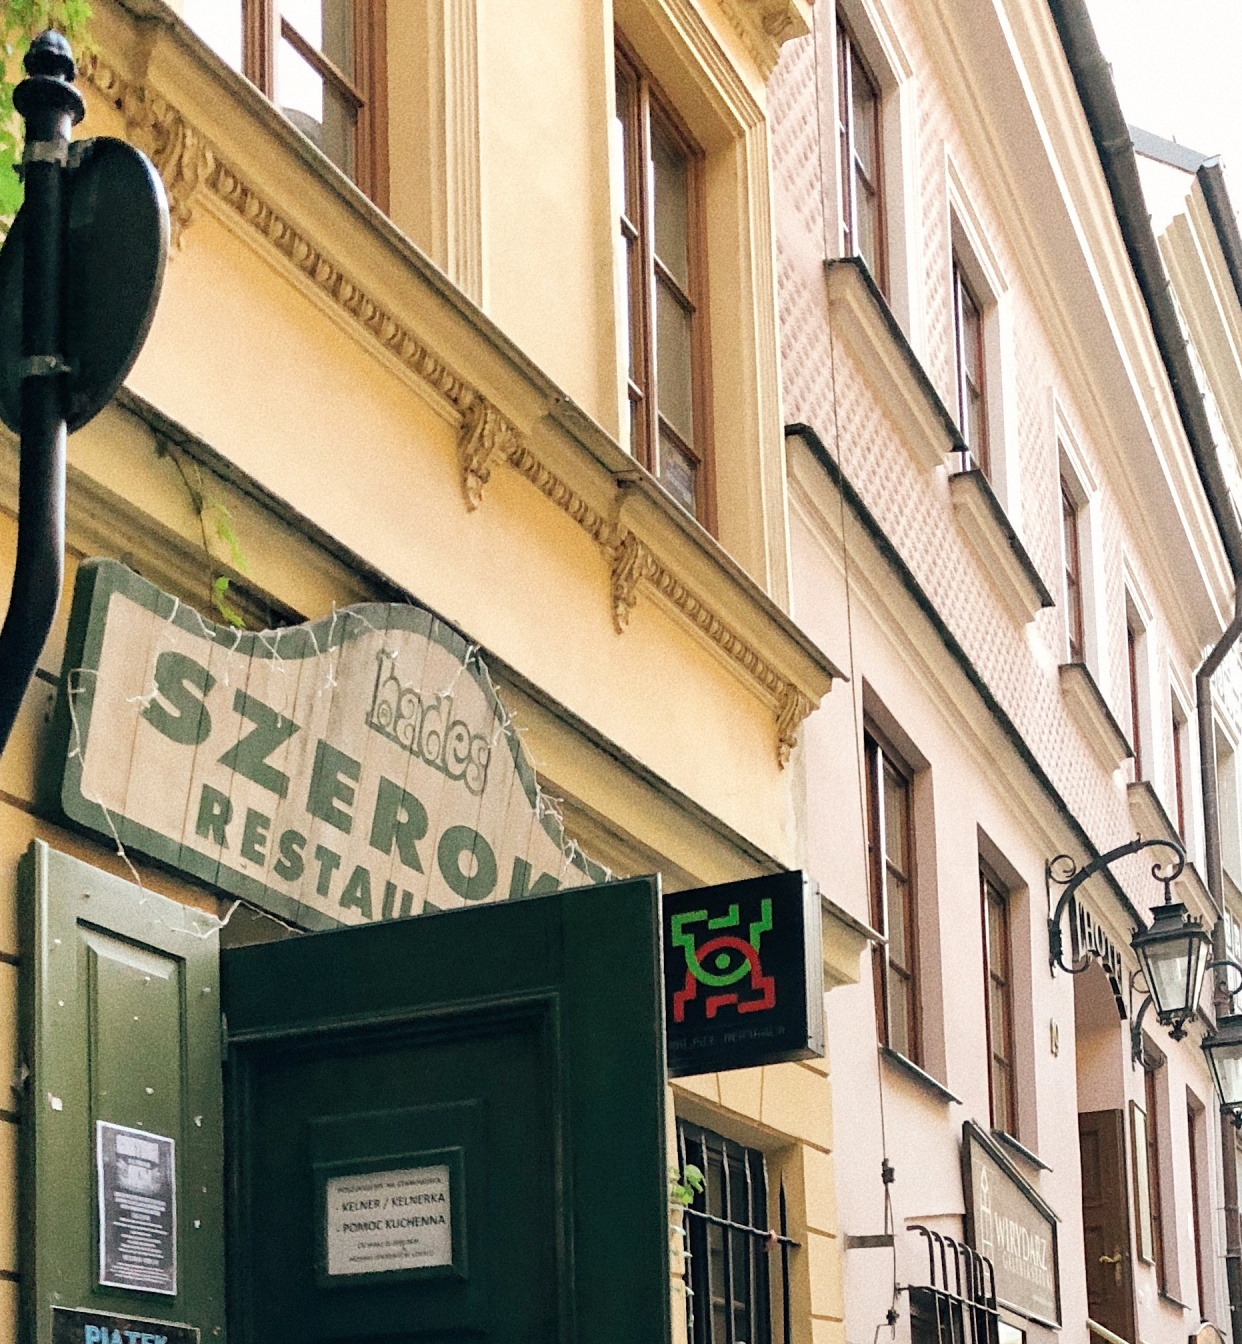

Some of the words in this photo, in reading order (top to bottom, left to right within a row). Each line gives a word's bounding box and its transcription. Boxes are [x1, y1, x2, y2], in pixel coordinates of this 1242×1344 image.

[195, 783, 442, 922] RESTAU
[342, 1199, 380, 1213] KELNER
[391, 1193, 446, 1207] KELNERKA
[342, 1220, 382, 1234] POMOC
[385, 1215, 446, 1230] KUCHENNA
[994, 1211, 1048, 1271] WIRYDARZ
